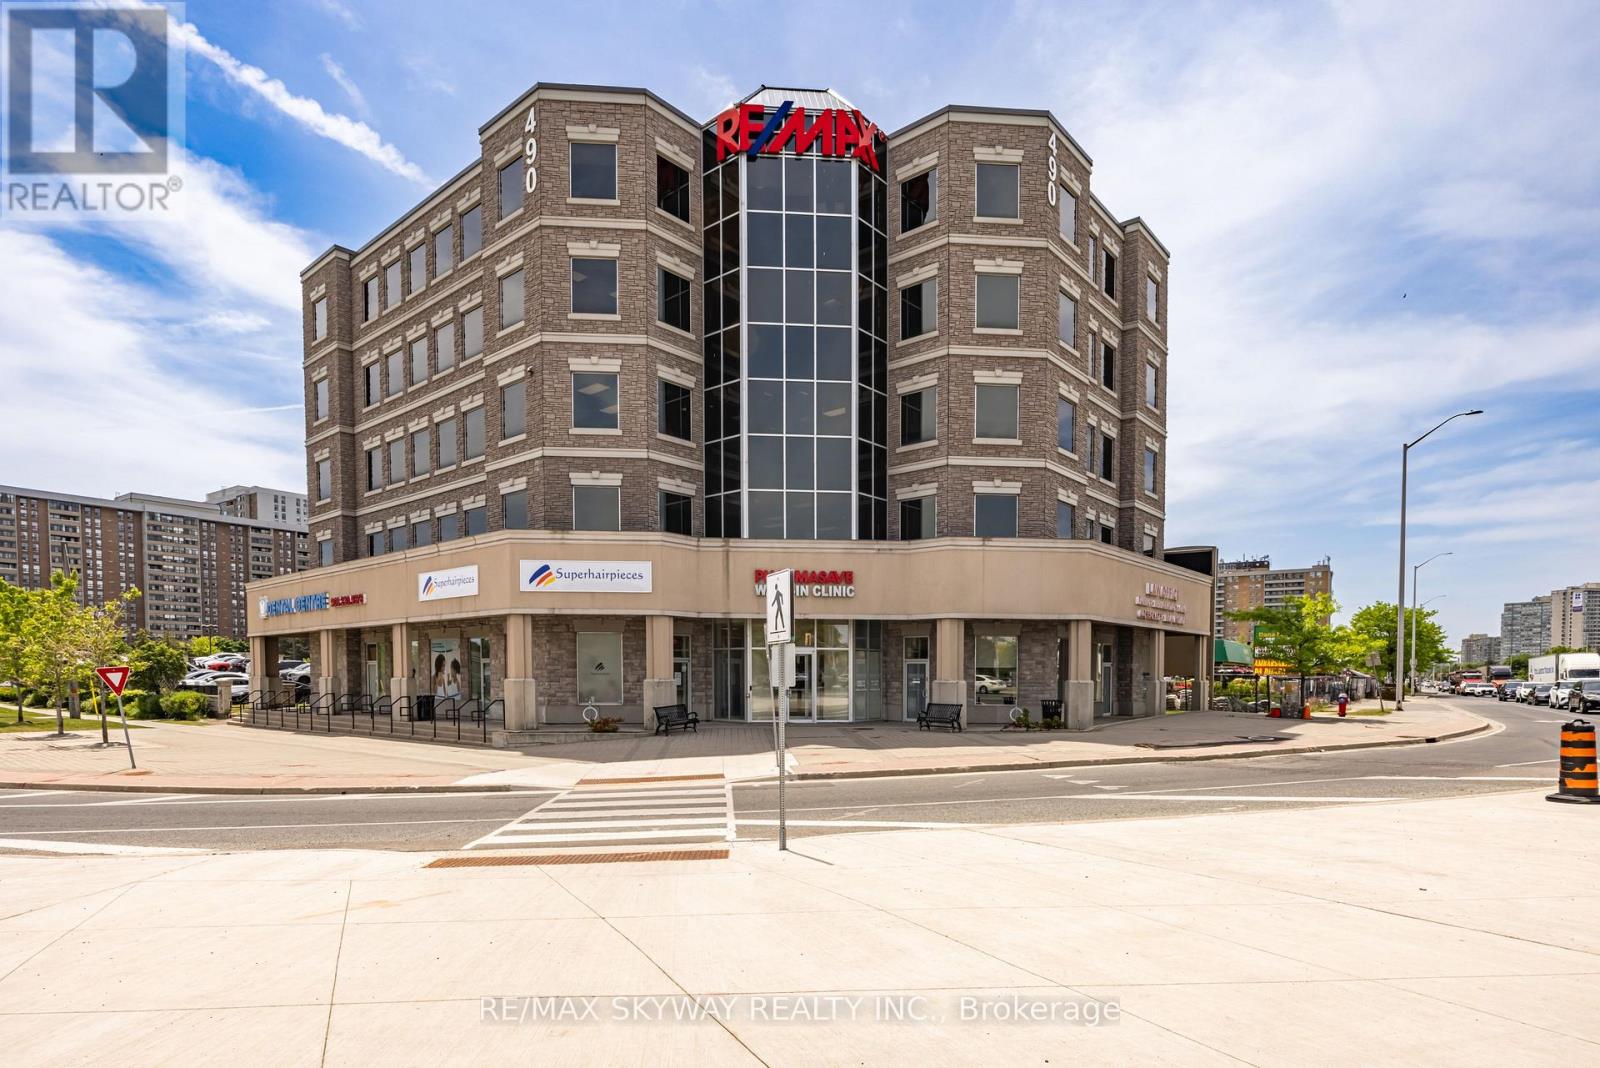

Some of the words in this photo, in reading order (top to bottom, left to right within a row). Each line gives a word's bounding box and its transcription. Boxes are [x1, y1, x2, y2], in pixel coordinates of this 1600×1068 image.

[716, 101, 880, 171] RE/MAX
[525, 107, 537, 194] 490
[1048, 132, 1057, 206] 490
[433, 575, 475, 589] Superhairpieces
[555, 567, 644, 582] Superhairpieces
[812, 585, 855, 597] CLINIC
[267, 598, 297, 617] DENTAL
[296, 592, 330, 613] CENTRE
